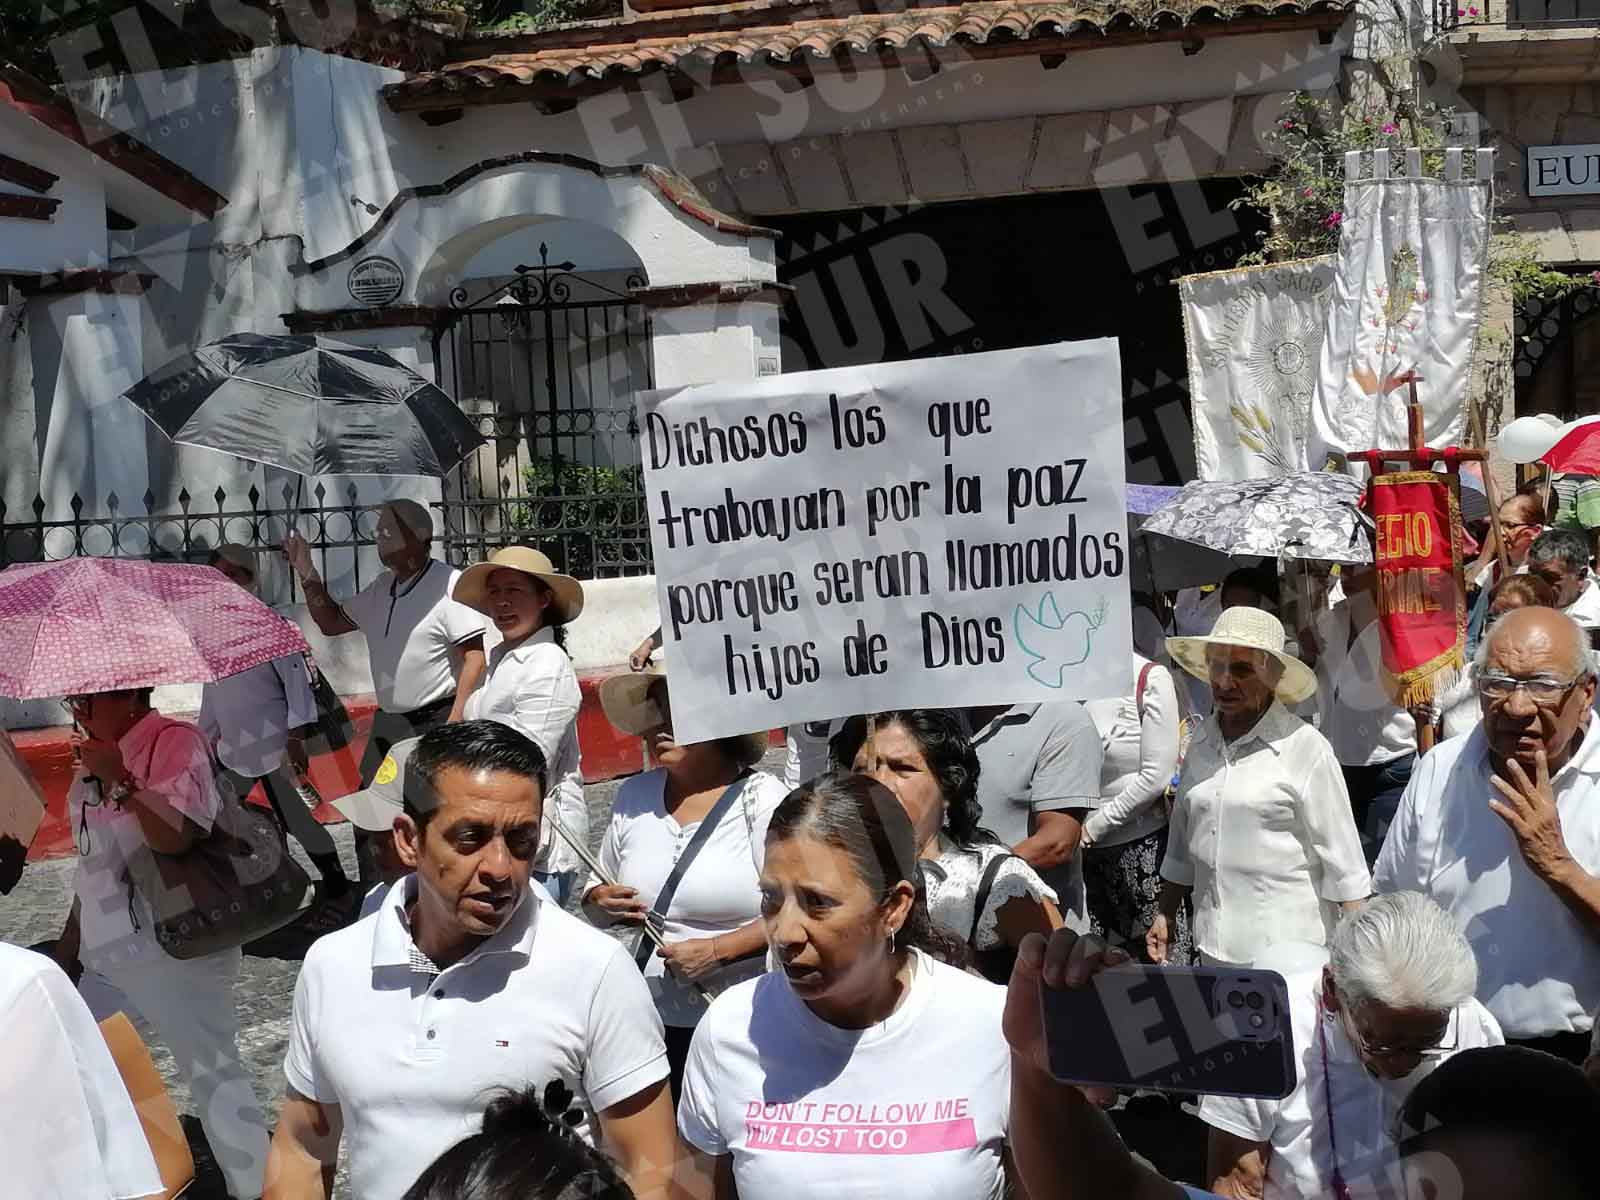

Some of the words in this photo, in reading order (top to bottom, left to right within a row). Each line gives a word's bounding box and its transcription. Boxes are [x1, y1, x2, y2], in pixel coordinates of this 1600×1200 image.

[1533, 154, 1600, 187] EU
[646, 411, 807, 470] Dichosos
[829, 393, 886, 450] los
[927, 398, 992, 456] que
[866, 481, 930, 536] por
[945, 464, 981, 515] la
[1007, 459, 1087, 524] paz
[667, 571, 799, 640] porque
[813, 551, 930, 606] seran
[945, 513, 1124, 593] llamados
[723, 634, 820, 700] hijos
[843, 618, 888, 677] de
[920, 611, 1005, 669] Dios
[746, 1100, 816, 1121] DON'T
[821, 1103, 927, 1123] FOLLOW
[934, 1098, 969, 1120] ME
[747, 1124, 777, 1145] I'M
[781, 1127, 848, 1147] LOST
[853, 1128, 908, 1148] TOO
